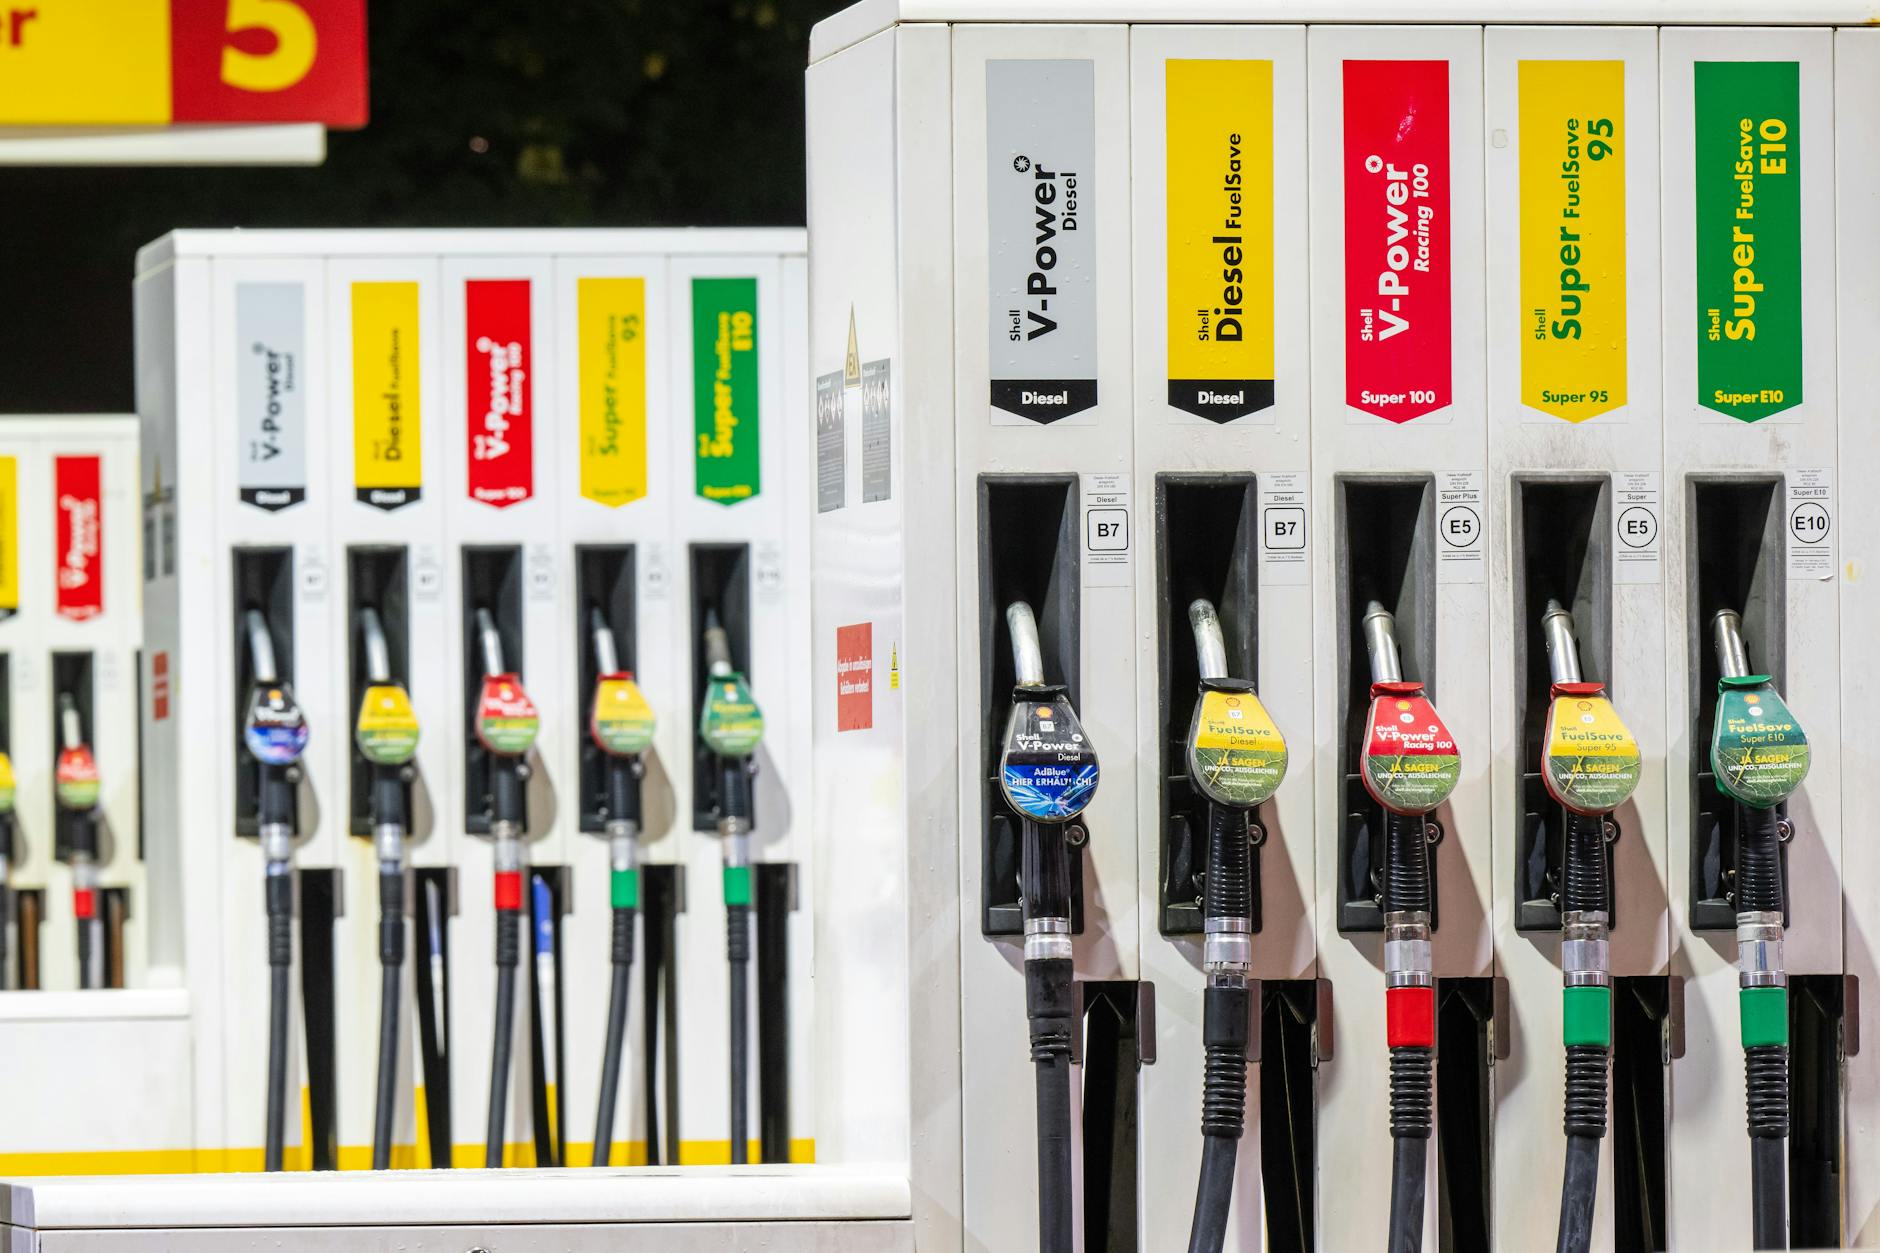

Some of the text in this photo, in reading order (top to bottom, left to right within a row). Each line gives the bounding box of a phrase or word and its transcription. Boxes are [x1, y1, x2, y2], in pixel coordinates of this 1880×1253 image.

[1588, 118, 1614, 161] 95
[1759, 118, 1787, 175] E10
[1062, 172, 1077, 231] Diesel
[1412, 163, 1434, 272] Racing 100
[1552, 118, 1589, 340] Super FuelSave
[1724, 118, 1763, 341] Super FuelSave
[1213, 133, 1243, 342] Diesel FuelSave
[1027, 164, 1058, 341] V-Power
[1378, 163, 1410, 341] V-Power
[1009, 310, 1021, 341] Shell
[1198, 310, 1210, 341] Shell
[1361, 308, 1373, 341] Shell
[1535, 308, 1546, 340] Shell
[1709, 308, 1720, 341] Shell
[1021, 391, 1068, 405] Diesel
[1198, 391, 1244, 405] Diesel
[1361, 390, 1436, 407] Super 100
[1542, 390, 1608, 406] Super 95
[1714, 390, 1784, 406] Super E10
[1097, 523, 1119, 537] B7
[1275, 522, 1297, 536] B7
[1450, 520, 1471, 533] E5
[1627, 521, 1648, 534] E5
[1795, 516, 1825, 530] E10
[1209, 725, 1270, 735] FuelSave
[1728, 723, 1792, 733] FuelSave
[1016, 733, 1039, 741] Shell
[1230, 736, 1256, 745] Diesel
[1377, 732, 1435, 741] V-Power
[1561, 732, 1623, 740] FuelSave
[1740, 733, 1784, 744] Super E10
[1017, 741, 1080, 751] V-Power
[1404, 741, 1434, 750] Racing
[1577, 743, 1616, 752] Super 95
[1058, 753, 1080, 761] Diesel
[1217, 757, 1265, 767] JA SAGEN
[1740, 754, 1789, 764] JA SAGEN
[1390, 764, 1438, 772] JA SAGEN
[1571, 764, 1620, 772] JA SAGEN
[1012, 778, 1033, 786] HIER
